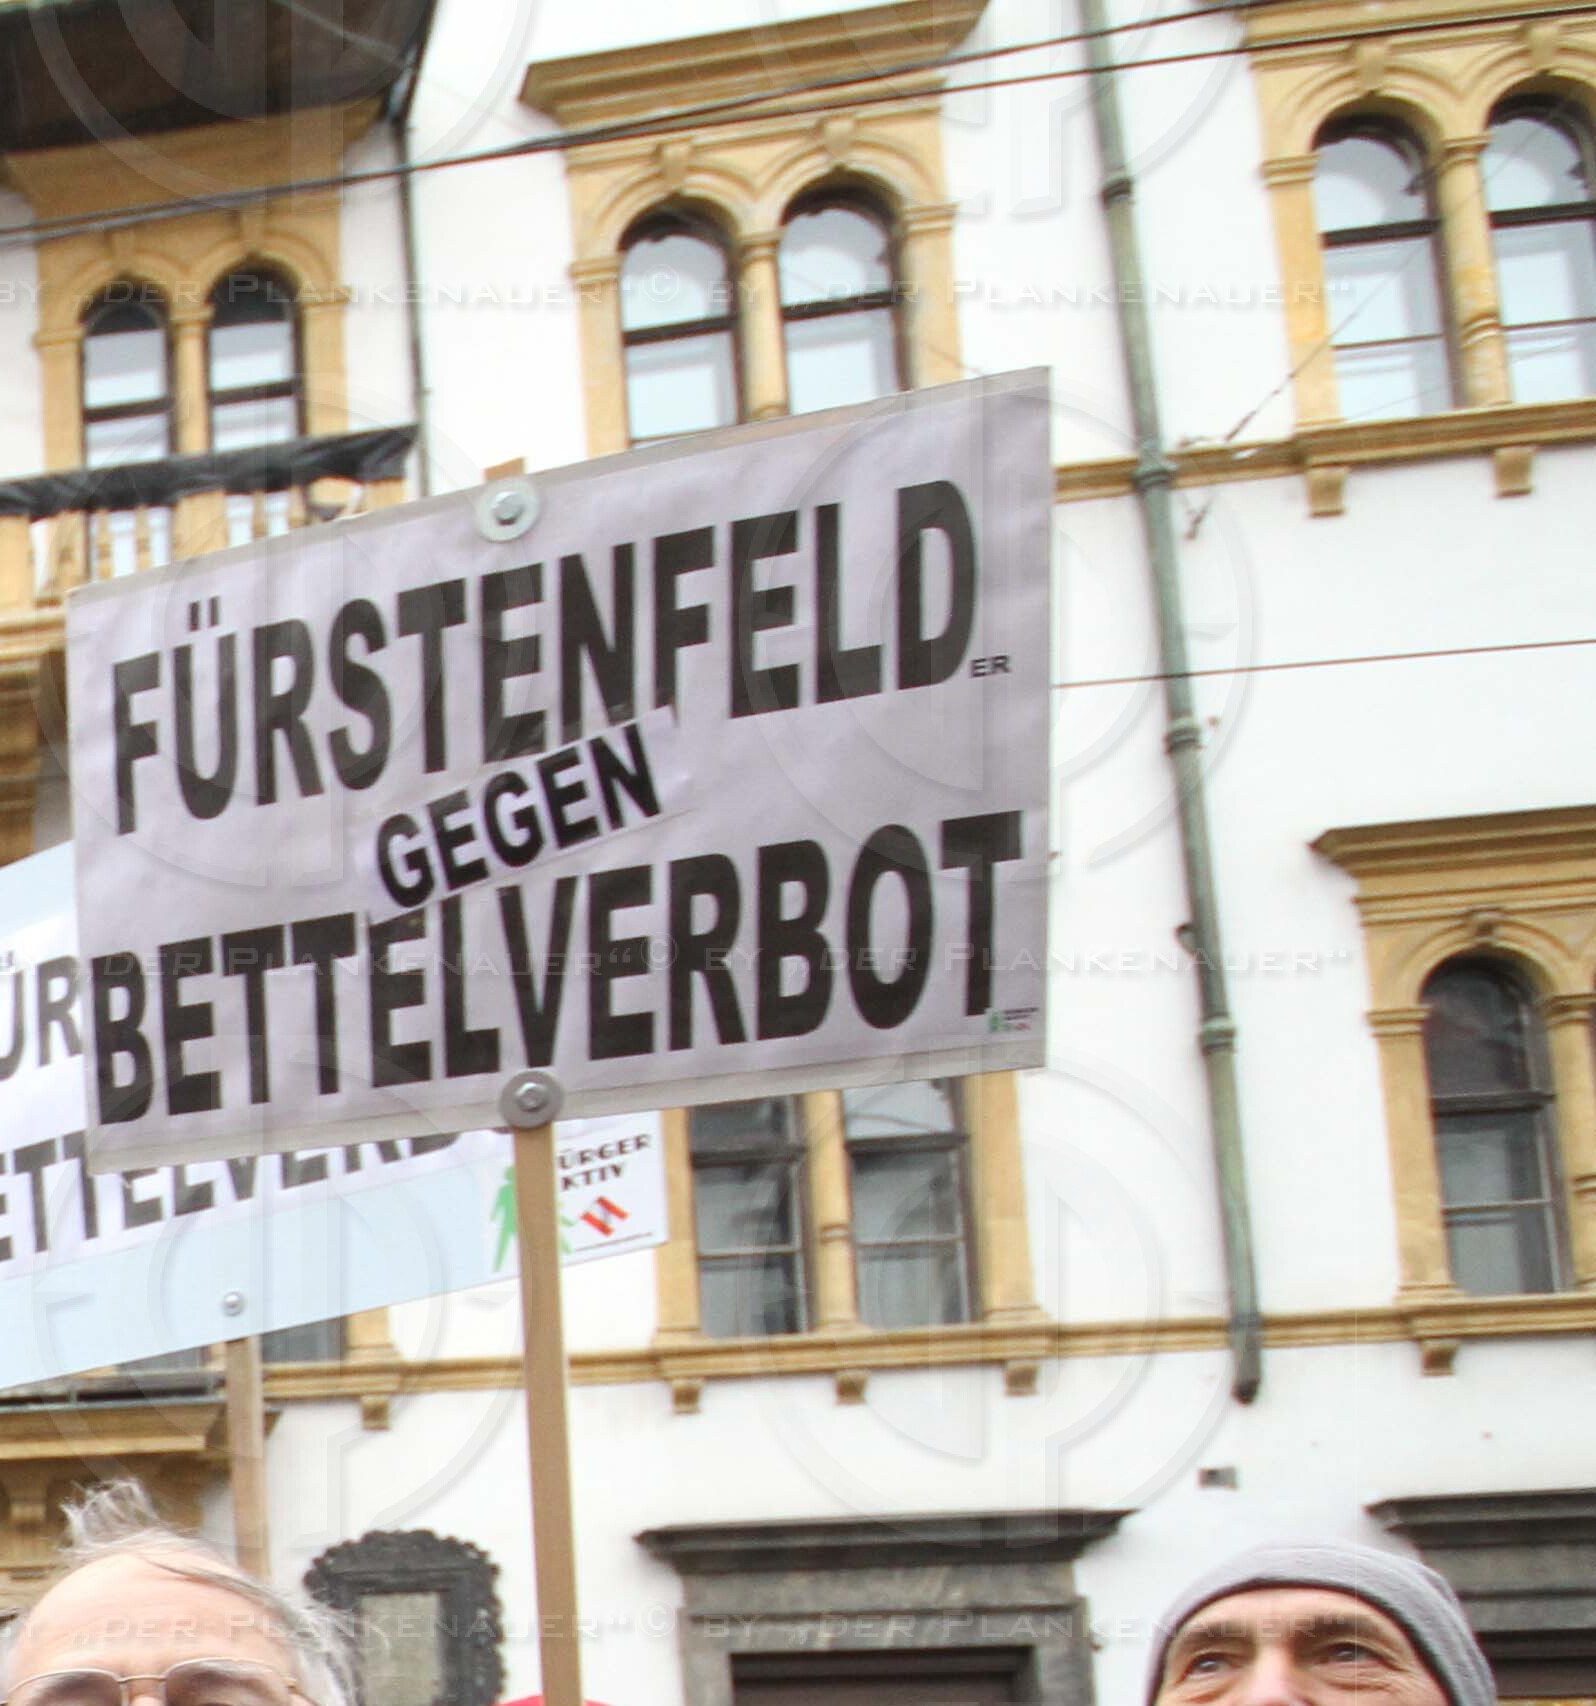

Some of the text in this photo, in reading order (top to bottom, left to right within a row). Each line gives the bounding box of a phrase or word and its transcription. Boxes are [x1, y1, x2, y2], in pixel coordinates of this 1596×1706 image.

[110, 478, 977, 836] FÜRSTENFELD
[378, 725, 664, 909] GEGEN
[89, 808, 1025, 1125] BETTELVERBOT
[561, 1164, 625, 1191] KTIV
